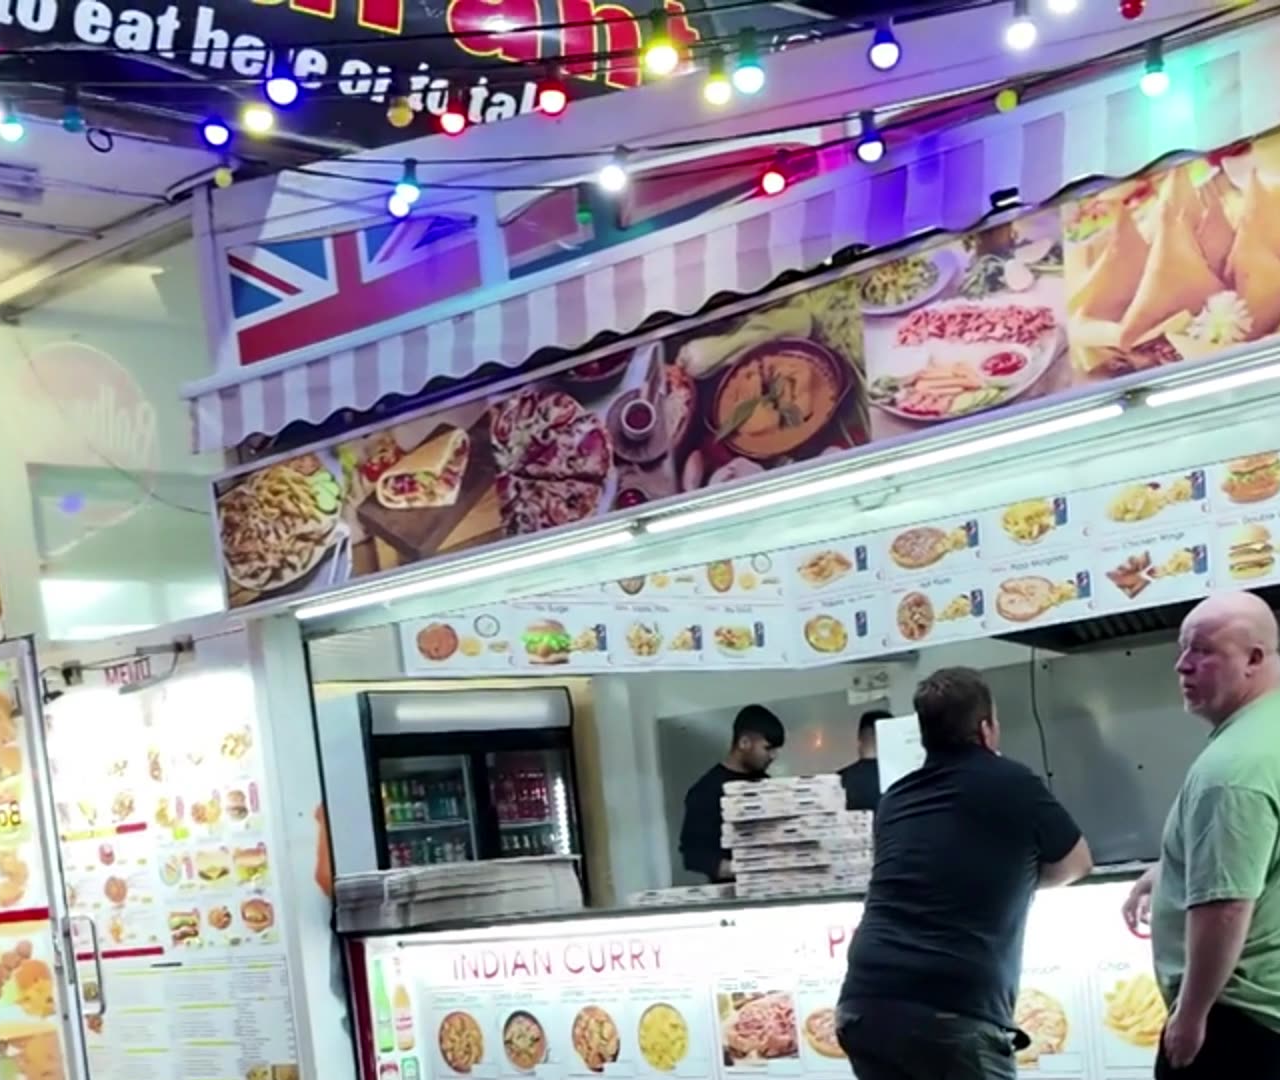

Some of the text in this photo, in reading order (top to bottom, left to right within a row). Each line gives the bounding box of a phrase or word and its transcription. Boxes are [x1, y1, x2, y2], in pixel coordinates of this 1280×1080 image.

[73, 0, 181, 59] eat
[339, 58, 392, 103] or
[104, 655, 152, 686] MENU
[452, 940, 663, 981] INDIAN CURRY
